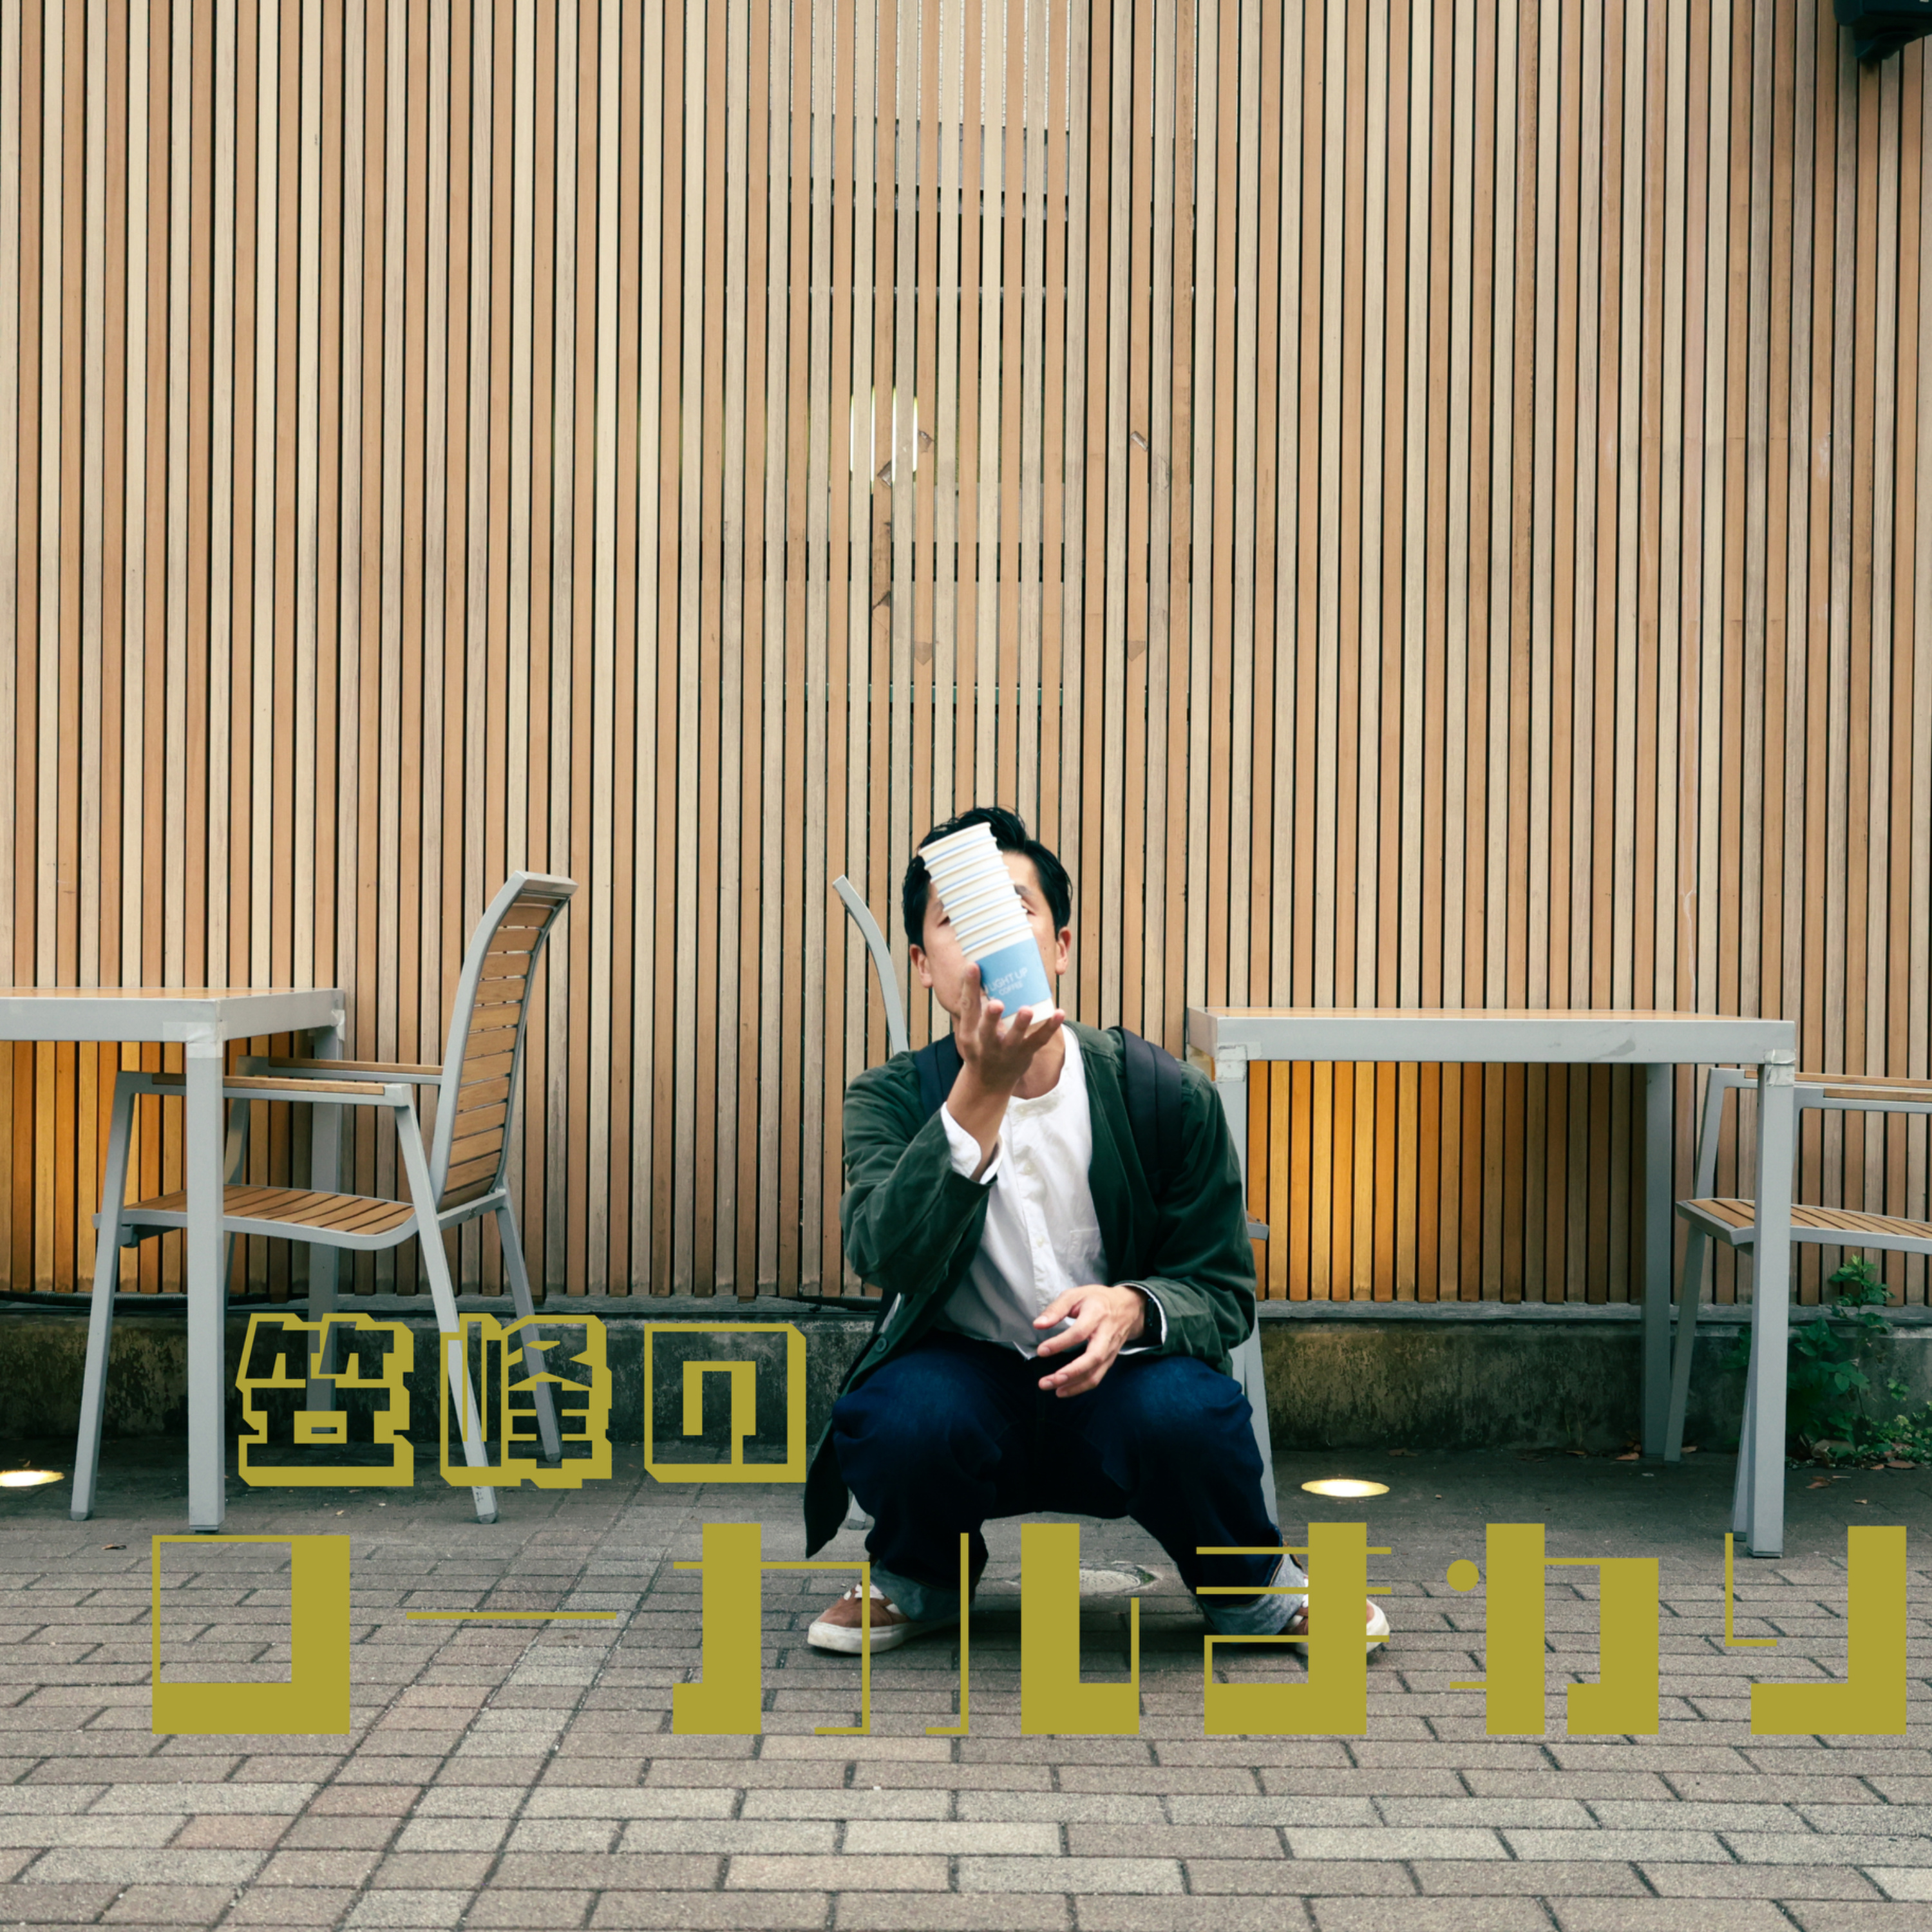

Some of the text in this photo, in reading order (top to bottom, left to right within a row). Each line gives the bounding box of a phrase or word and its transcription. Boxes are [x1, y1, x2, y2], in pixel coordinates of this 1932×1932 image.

[988, 967, 1028, 991] LIGHT UP
[998, 980, 1024, 996] COFFEE
